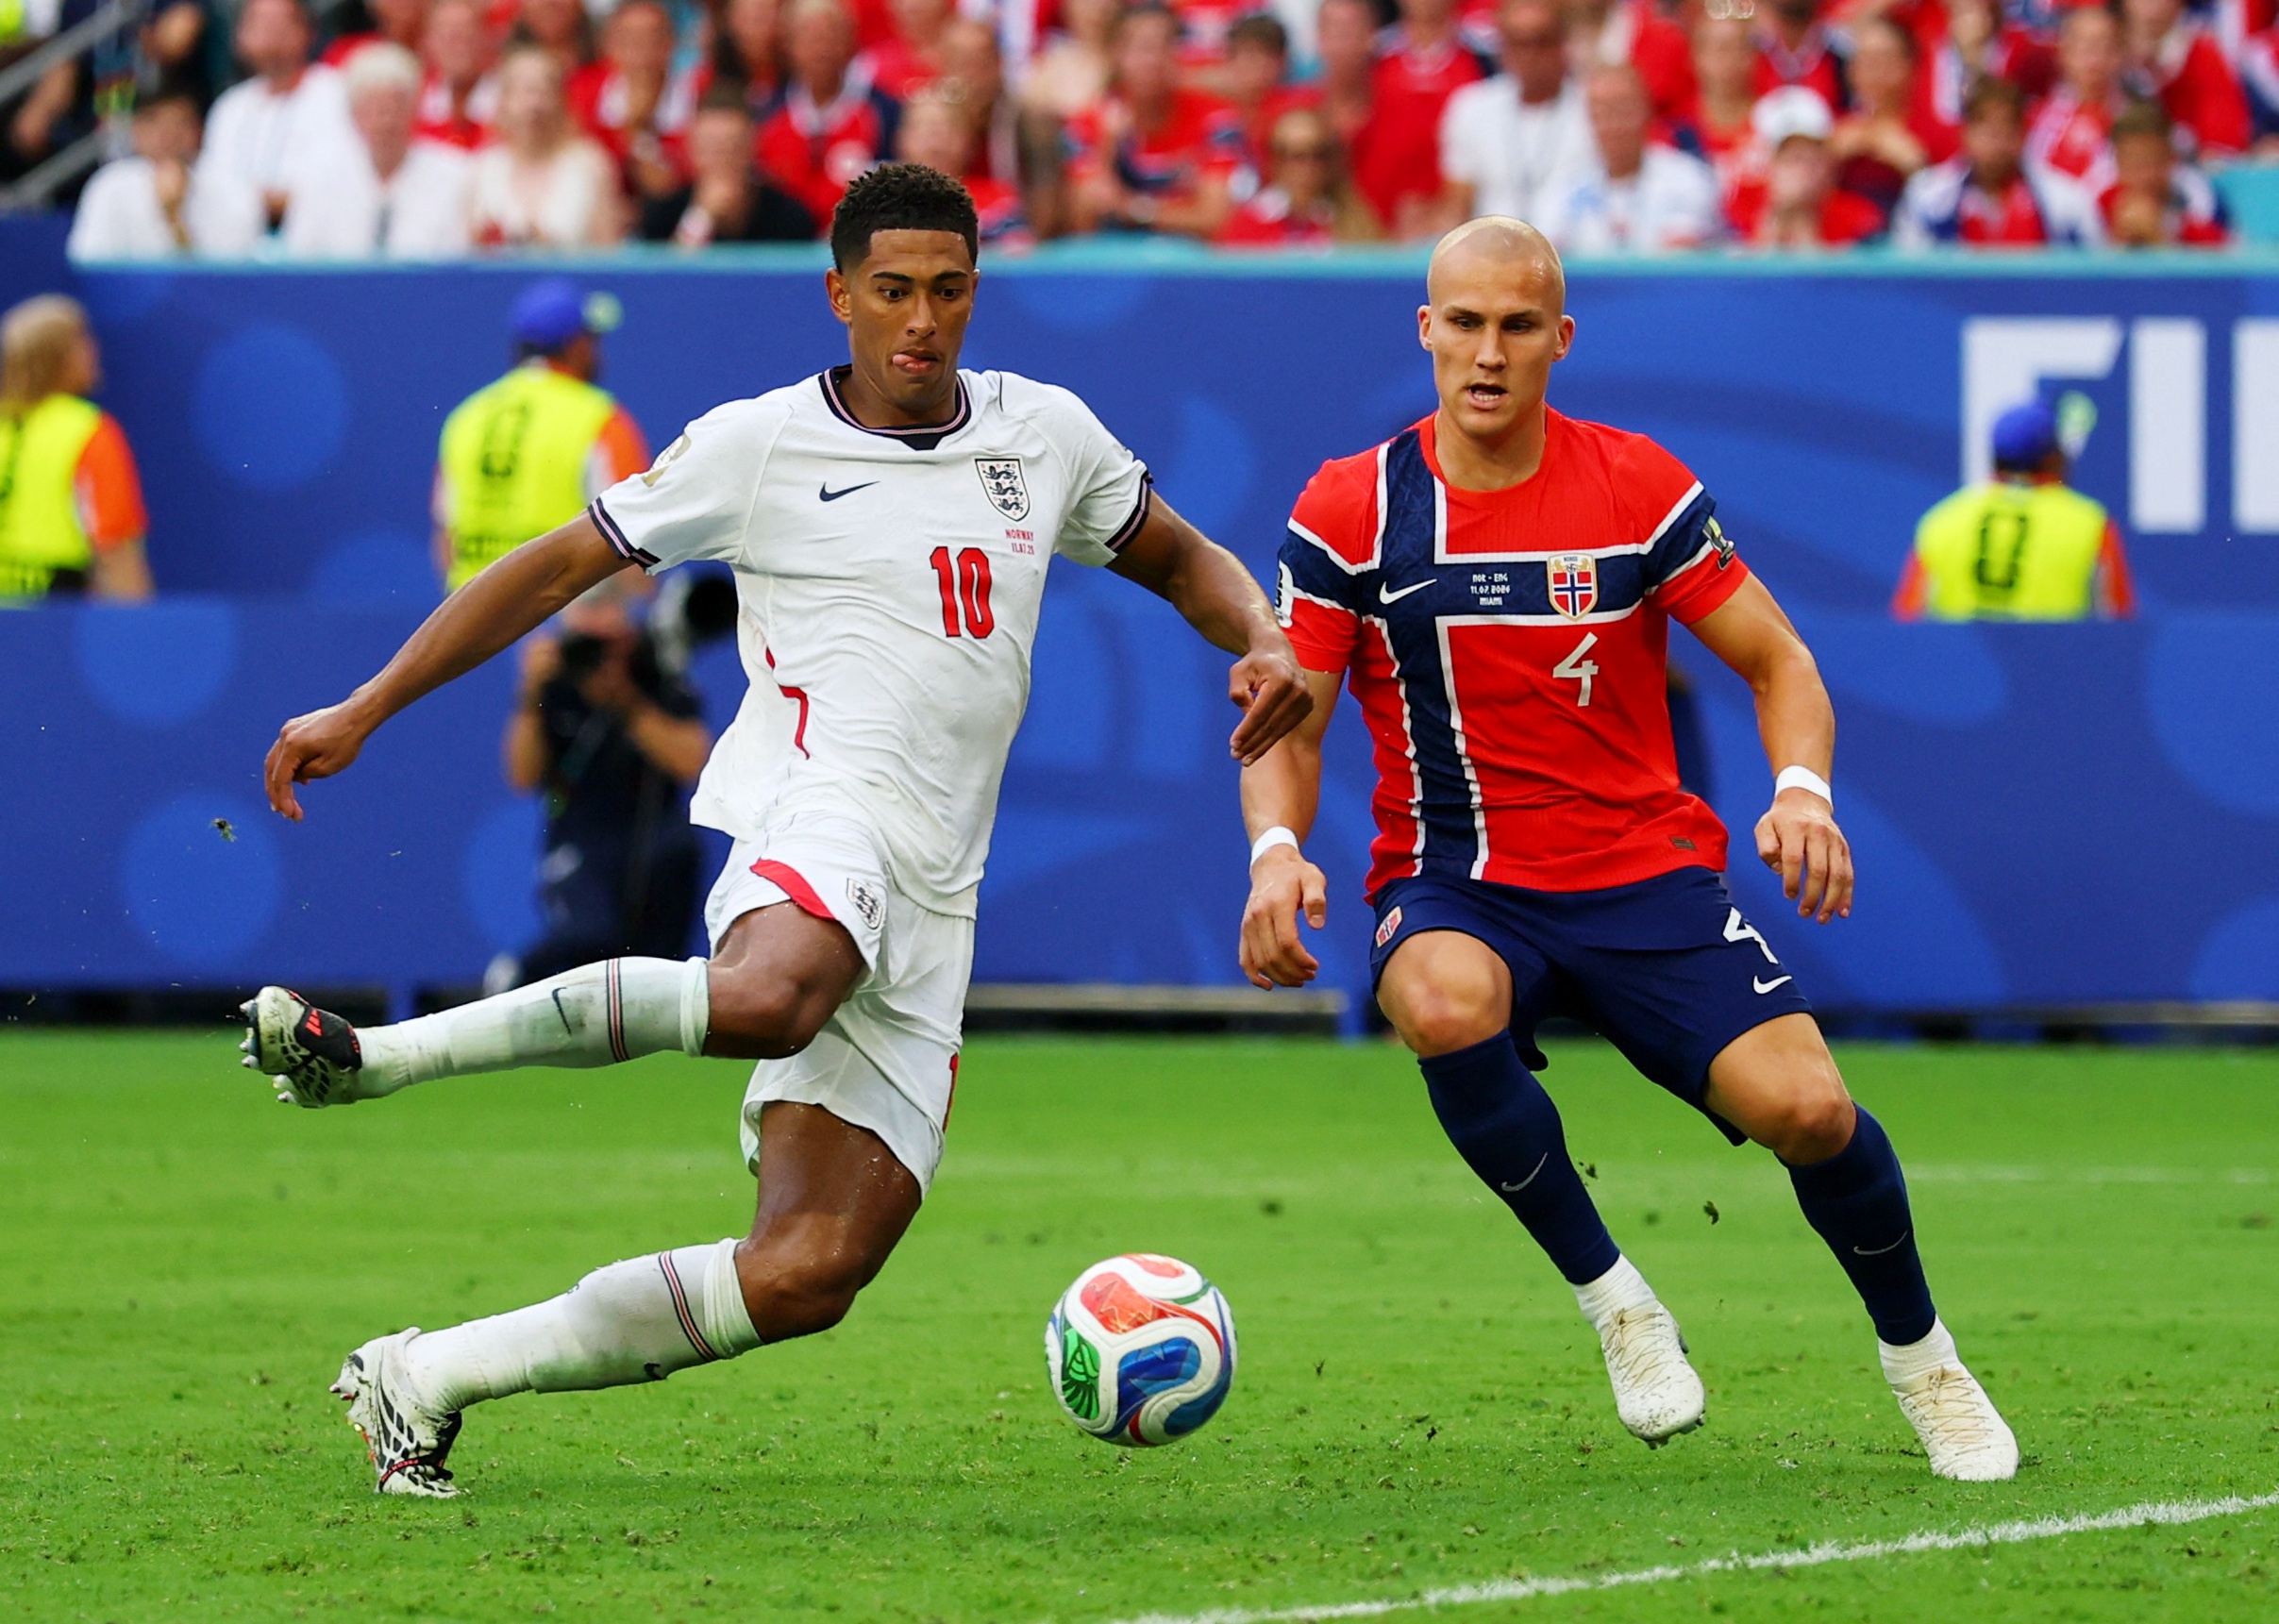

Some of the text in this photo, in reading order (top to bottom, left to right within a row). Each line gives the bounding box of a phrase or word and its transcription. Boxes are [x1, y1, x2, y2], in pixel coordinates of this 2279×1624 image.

[1005, 528, 1034, 542] NORWAY
[930, 545, 995, 639] 10
[1552, 631, 1599, 707] 4
[1722, 906, 1779, 964] 4
